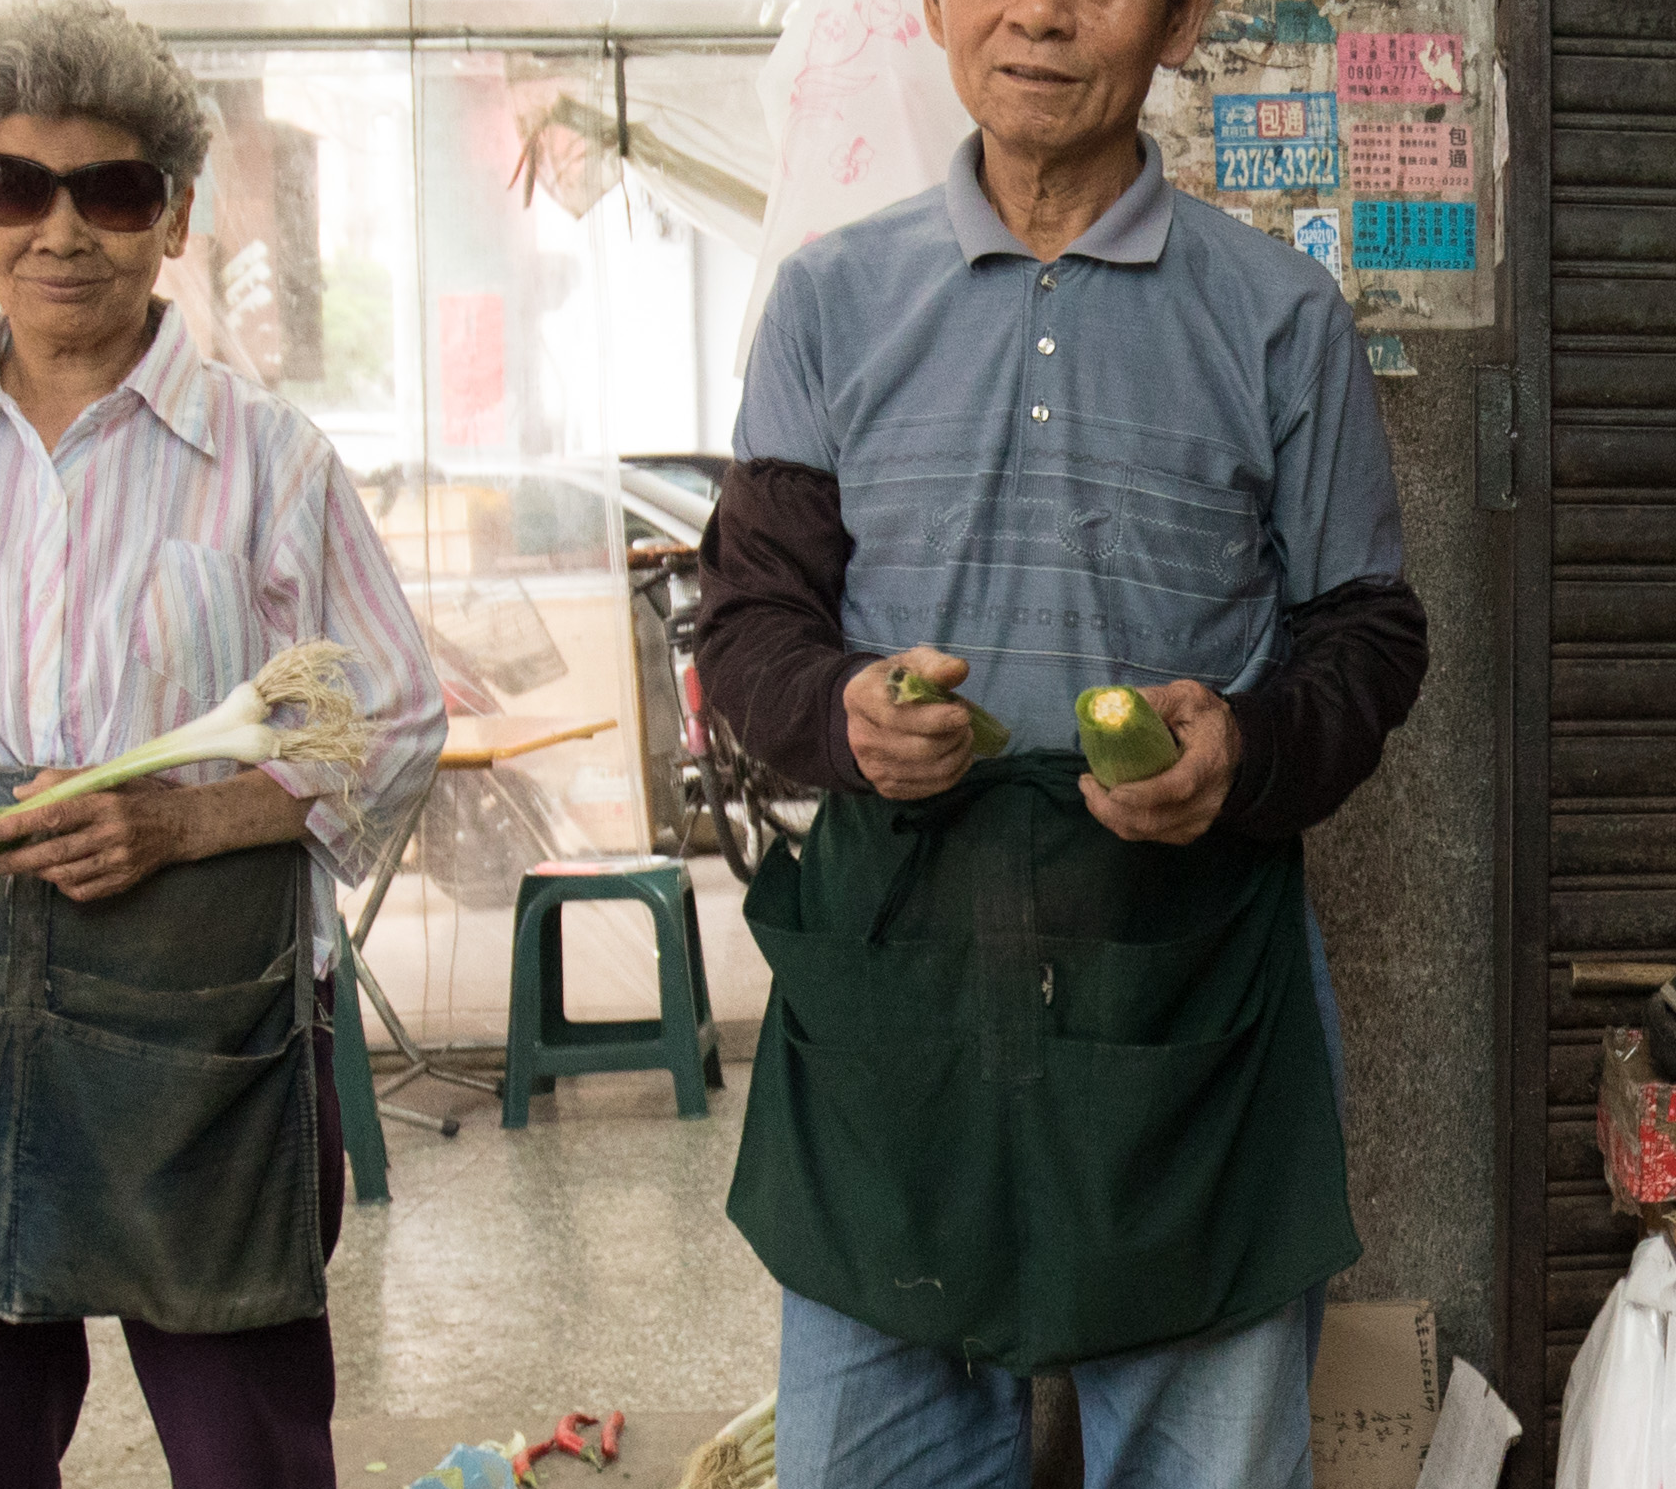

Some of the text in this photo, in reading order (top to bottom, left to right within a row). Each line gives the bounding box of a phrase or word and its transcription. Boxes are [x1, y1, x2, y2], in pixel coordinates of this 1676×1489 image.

[1258, 101, 1304, 138] 包通
[1222, 147, 1336, 188] 2375-3322
[1448, 126, 1468, 169] 包通
